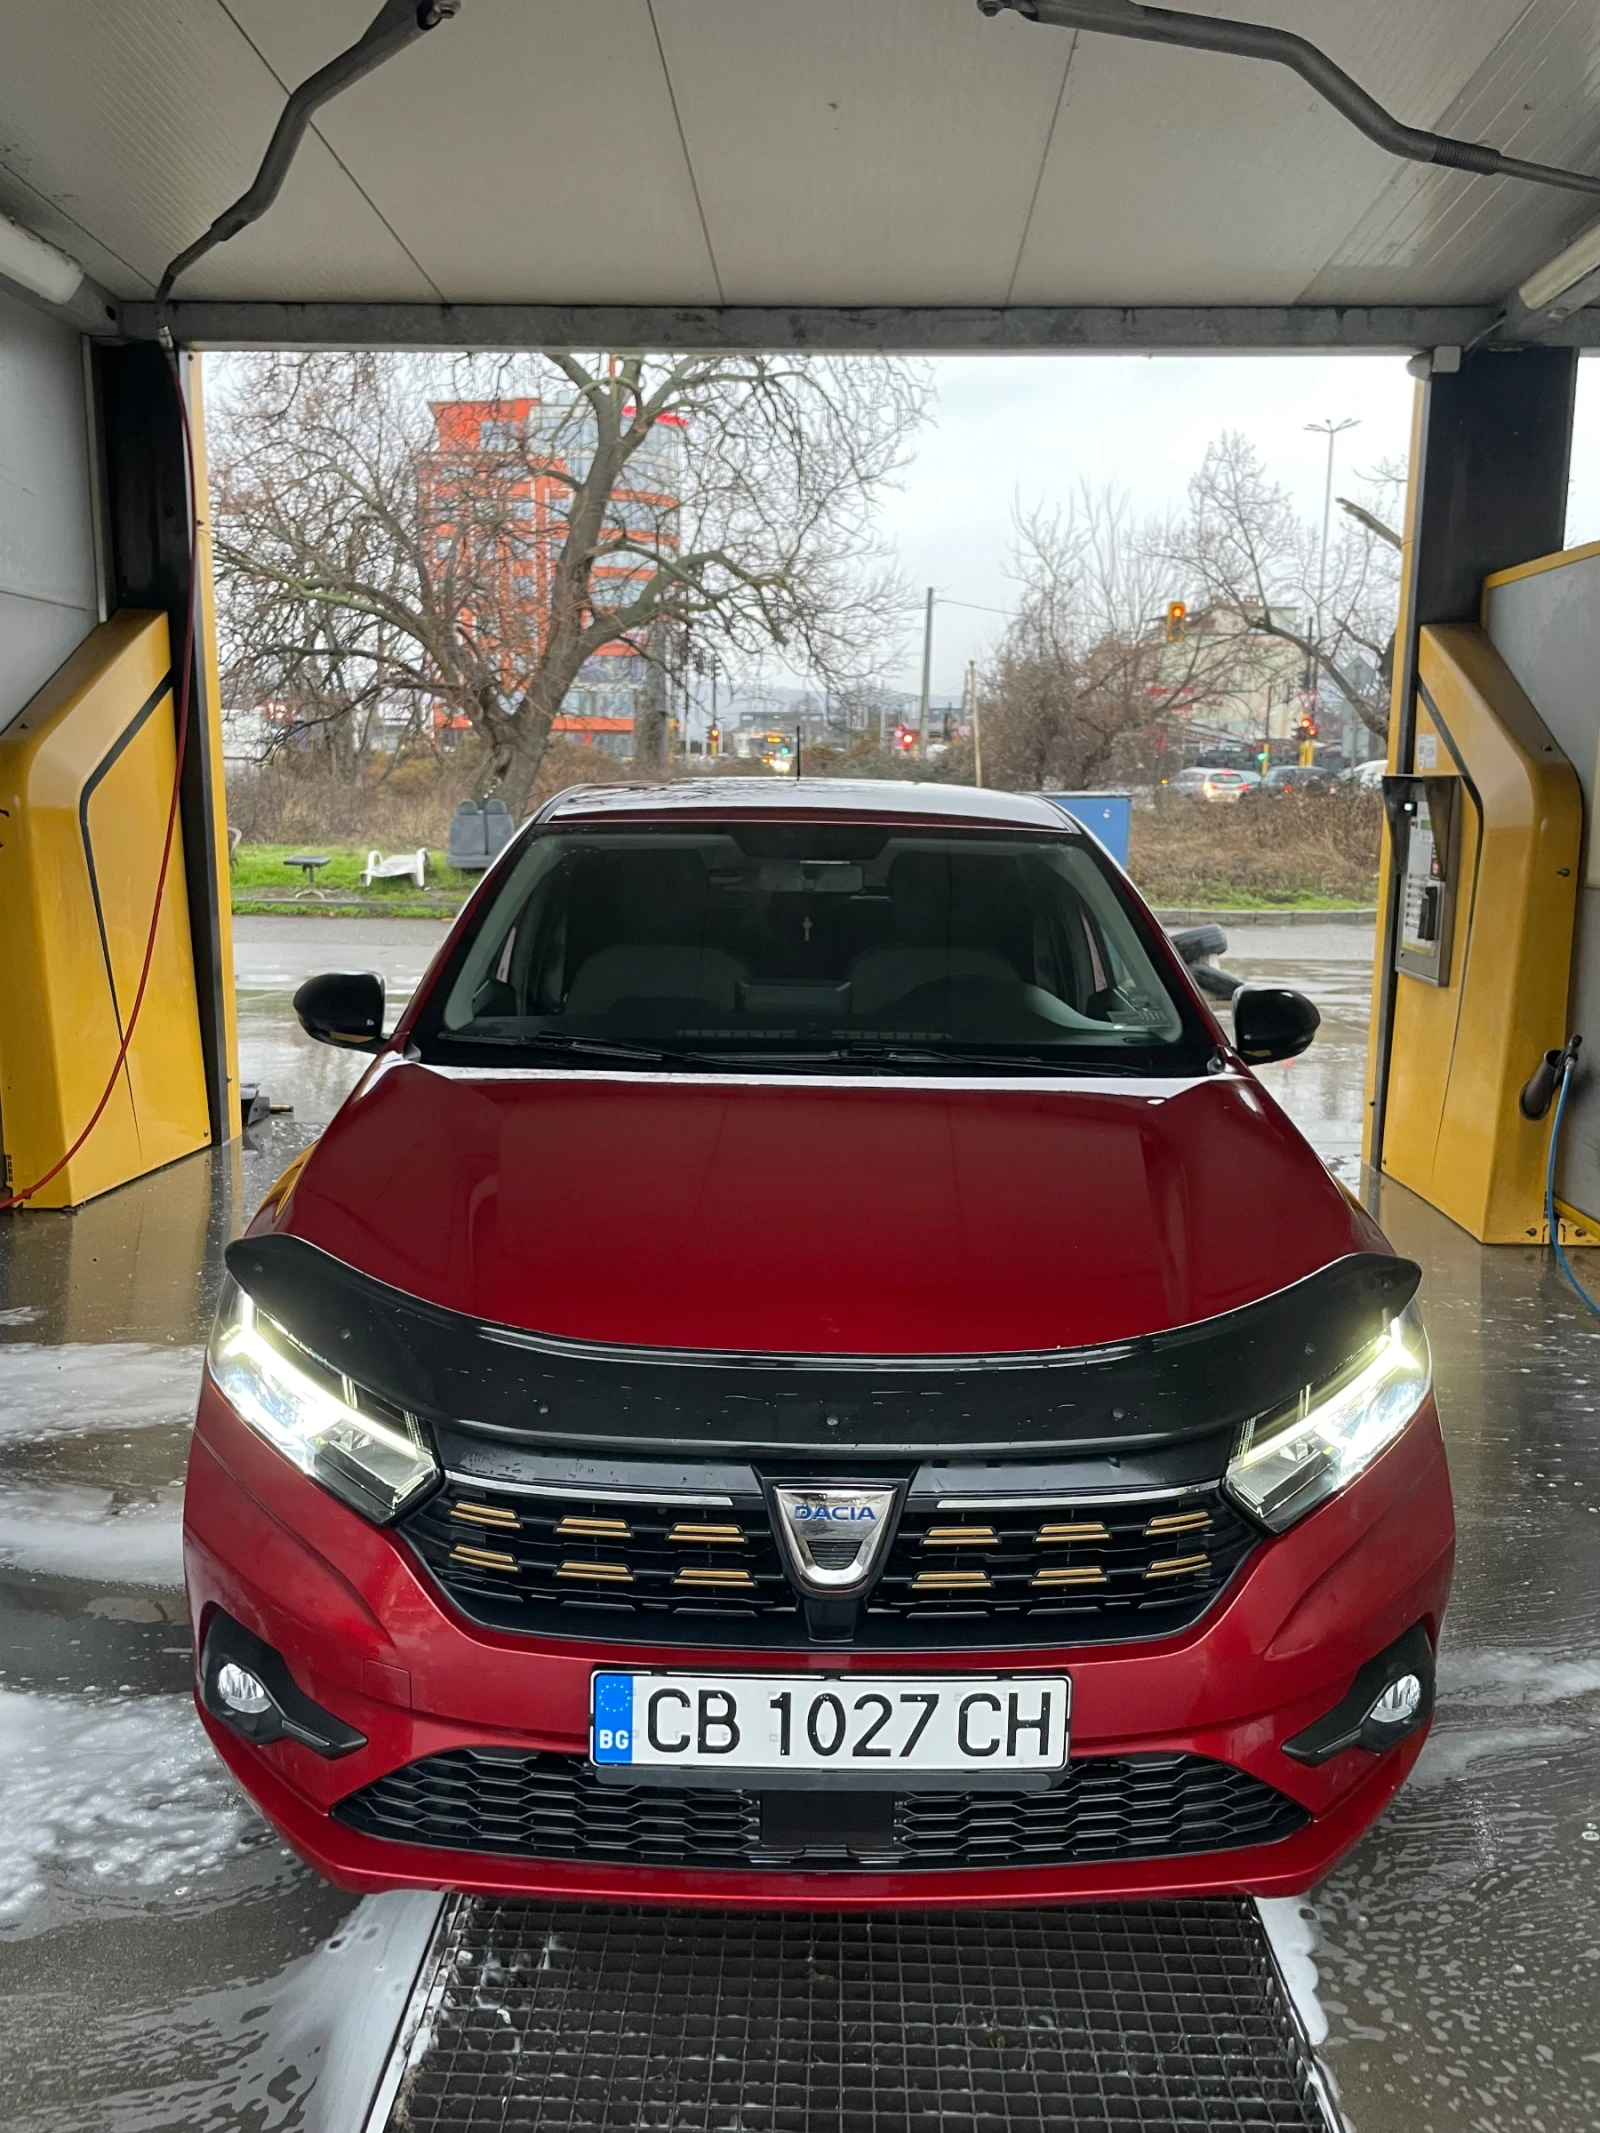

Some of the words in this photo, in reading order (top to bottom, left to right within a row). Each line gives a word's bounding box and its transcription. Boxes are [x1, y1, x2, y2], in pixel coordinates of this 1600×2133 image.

[795, 1505, 876, 1520] DACIA
[648, 1688, 741, 1754] CB
[770, 1692, 939, 1757] 1027
[958, 1692, 1050, 1757] CH
[599, 1729, 629, 1749] BG
